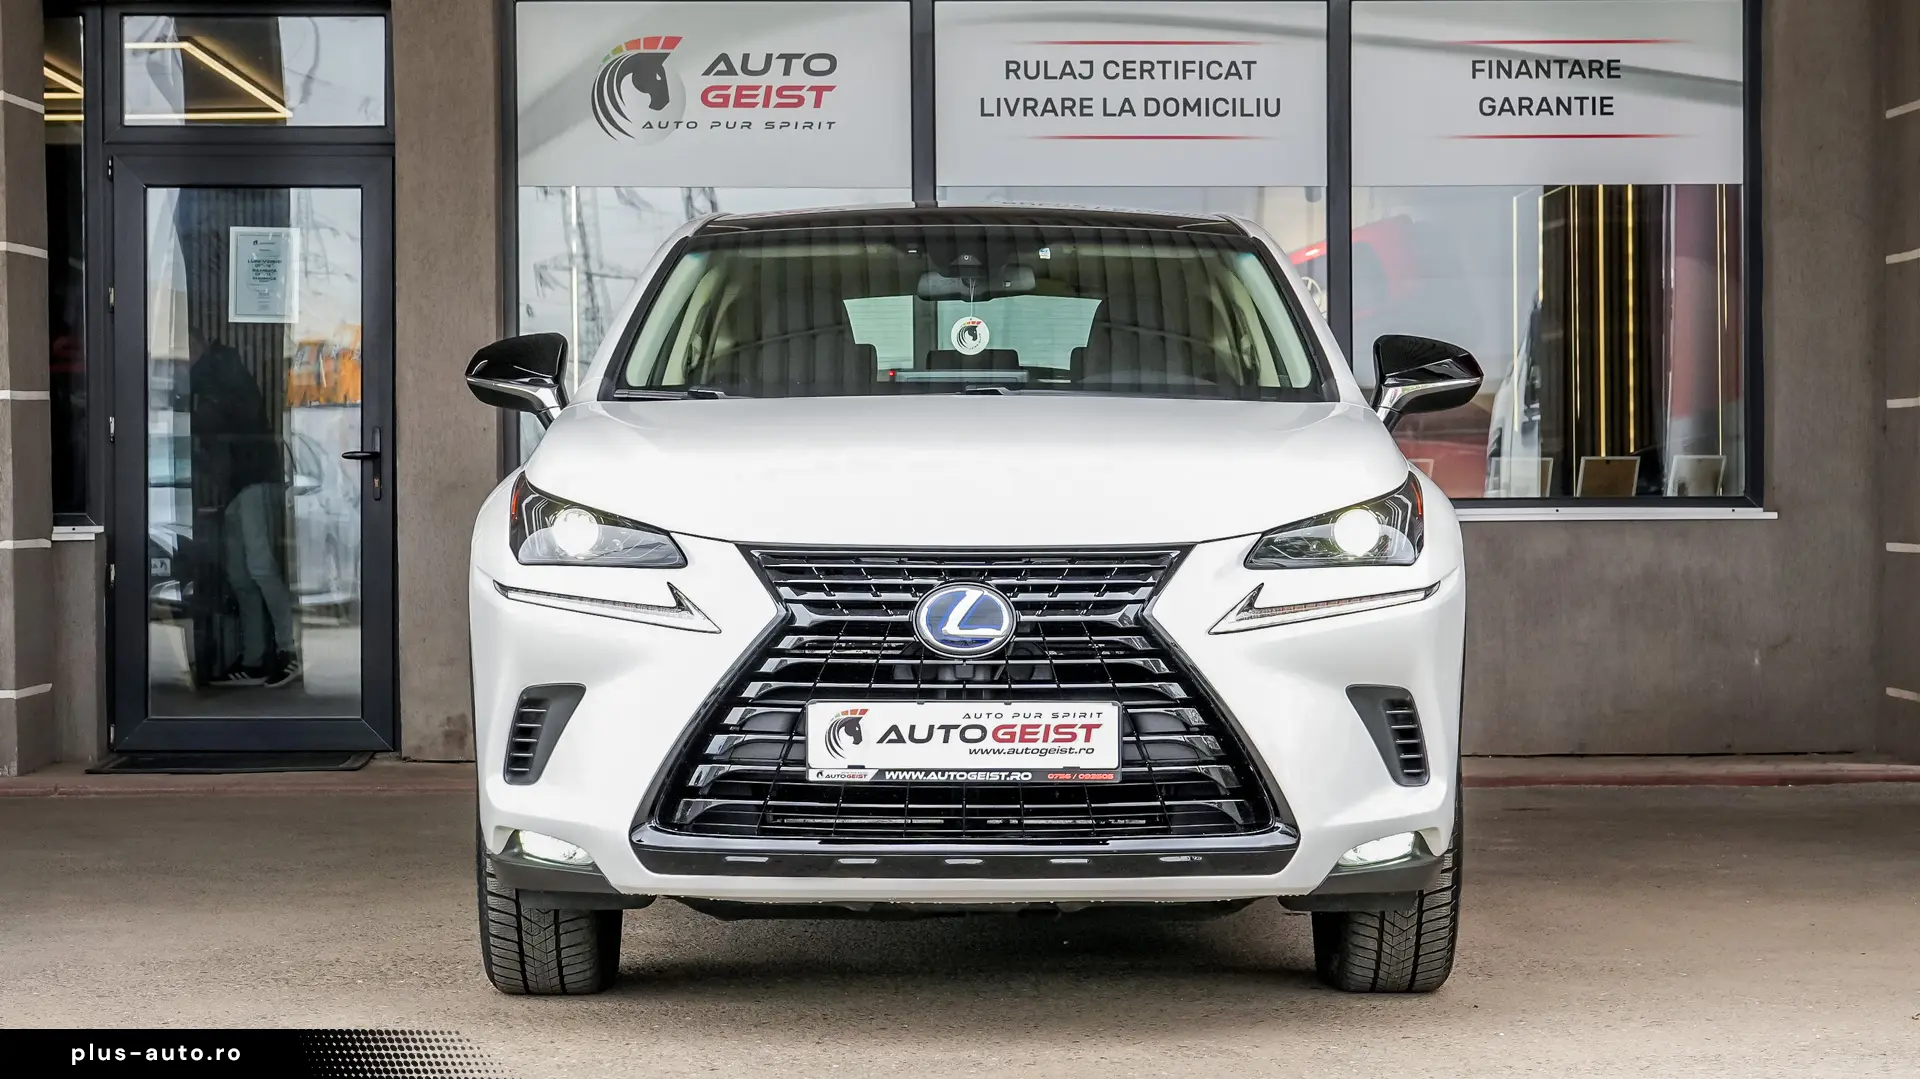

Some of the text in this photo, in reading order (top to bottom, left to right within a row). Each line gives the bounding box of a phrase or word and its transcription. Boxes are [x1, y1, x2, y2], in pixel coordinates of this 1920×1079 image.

[701, 52, 838, 77] AUTO
[1005, 60, 1257, 80] RULAJ CERTIFICAT
[1471, 59, 1621, 80] FINANTARE
[700, 85, 837, 109] GEIST
[980, 97, 1281, 117] LIVRARE LA DOMICILIU
[1479, 96, 1614, 116] GARANTIE
[641, 120, 836, 130] AUTO PUR SPIRIT
[876, 723, 1103, 744] AUTOGEIST
[968, 746, 1095, 757] www.autogeist.ro
[885, 771, 1032, 781] WWW.AUTOGEIST.RO
